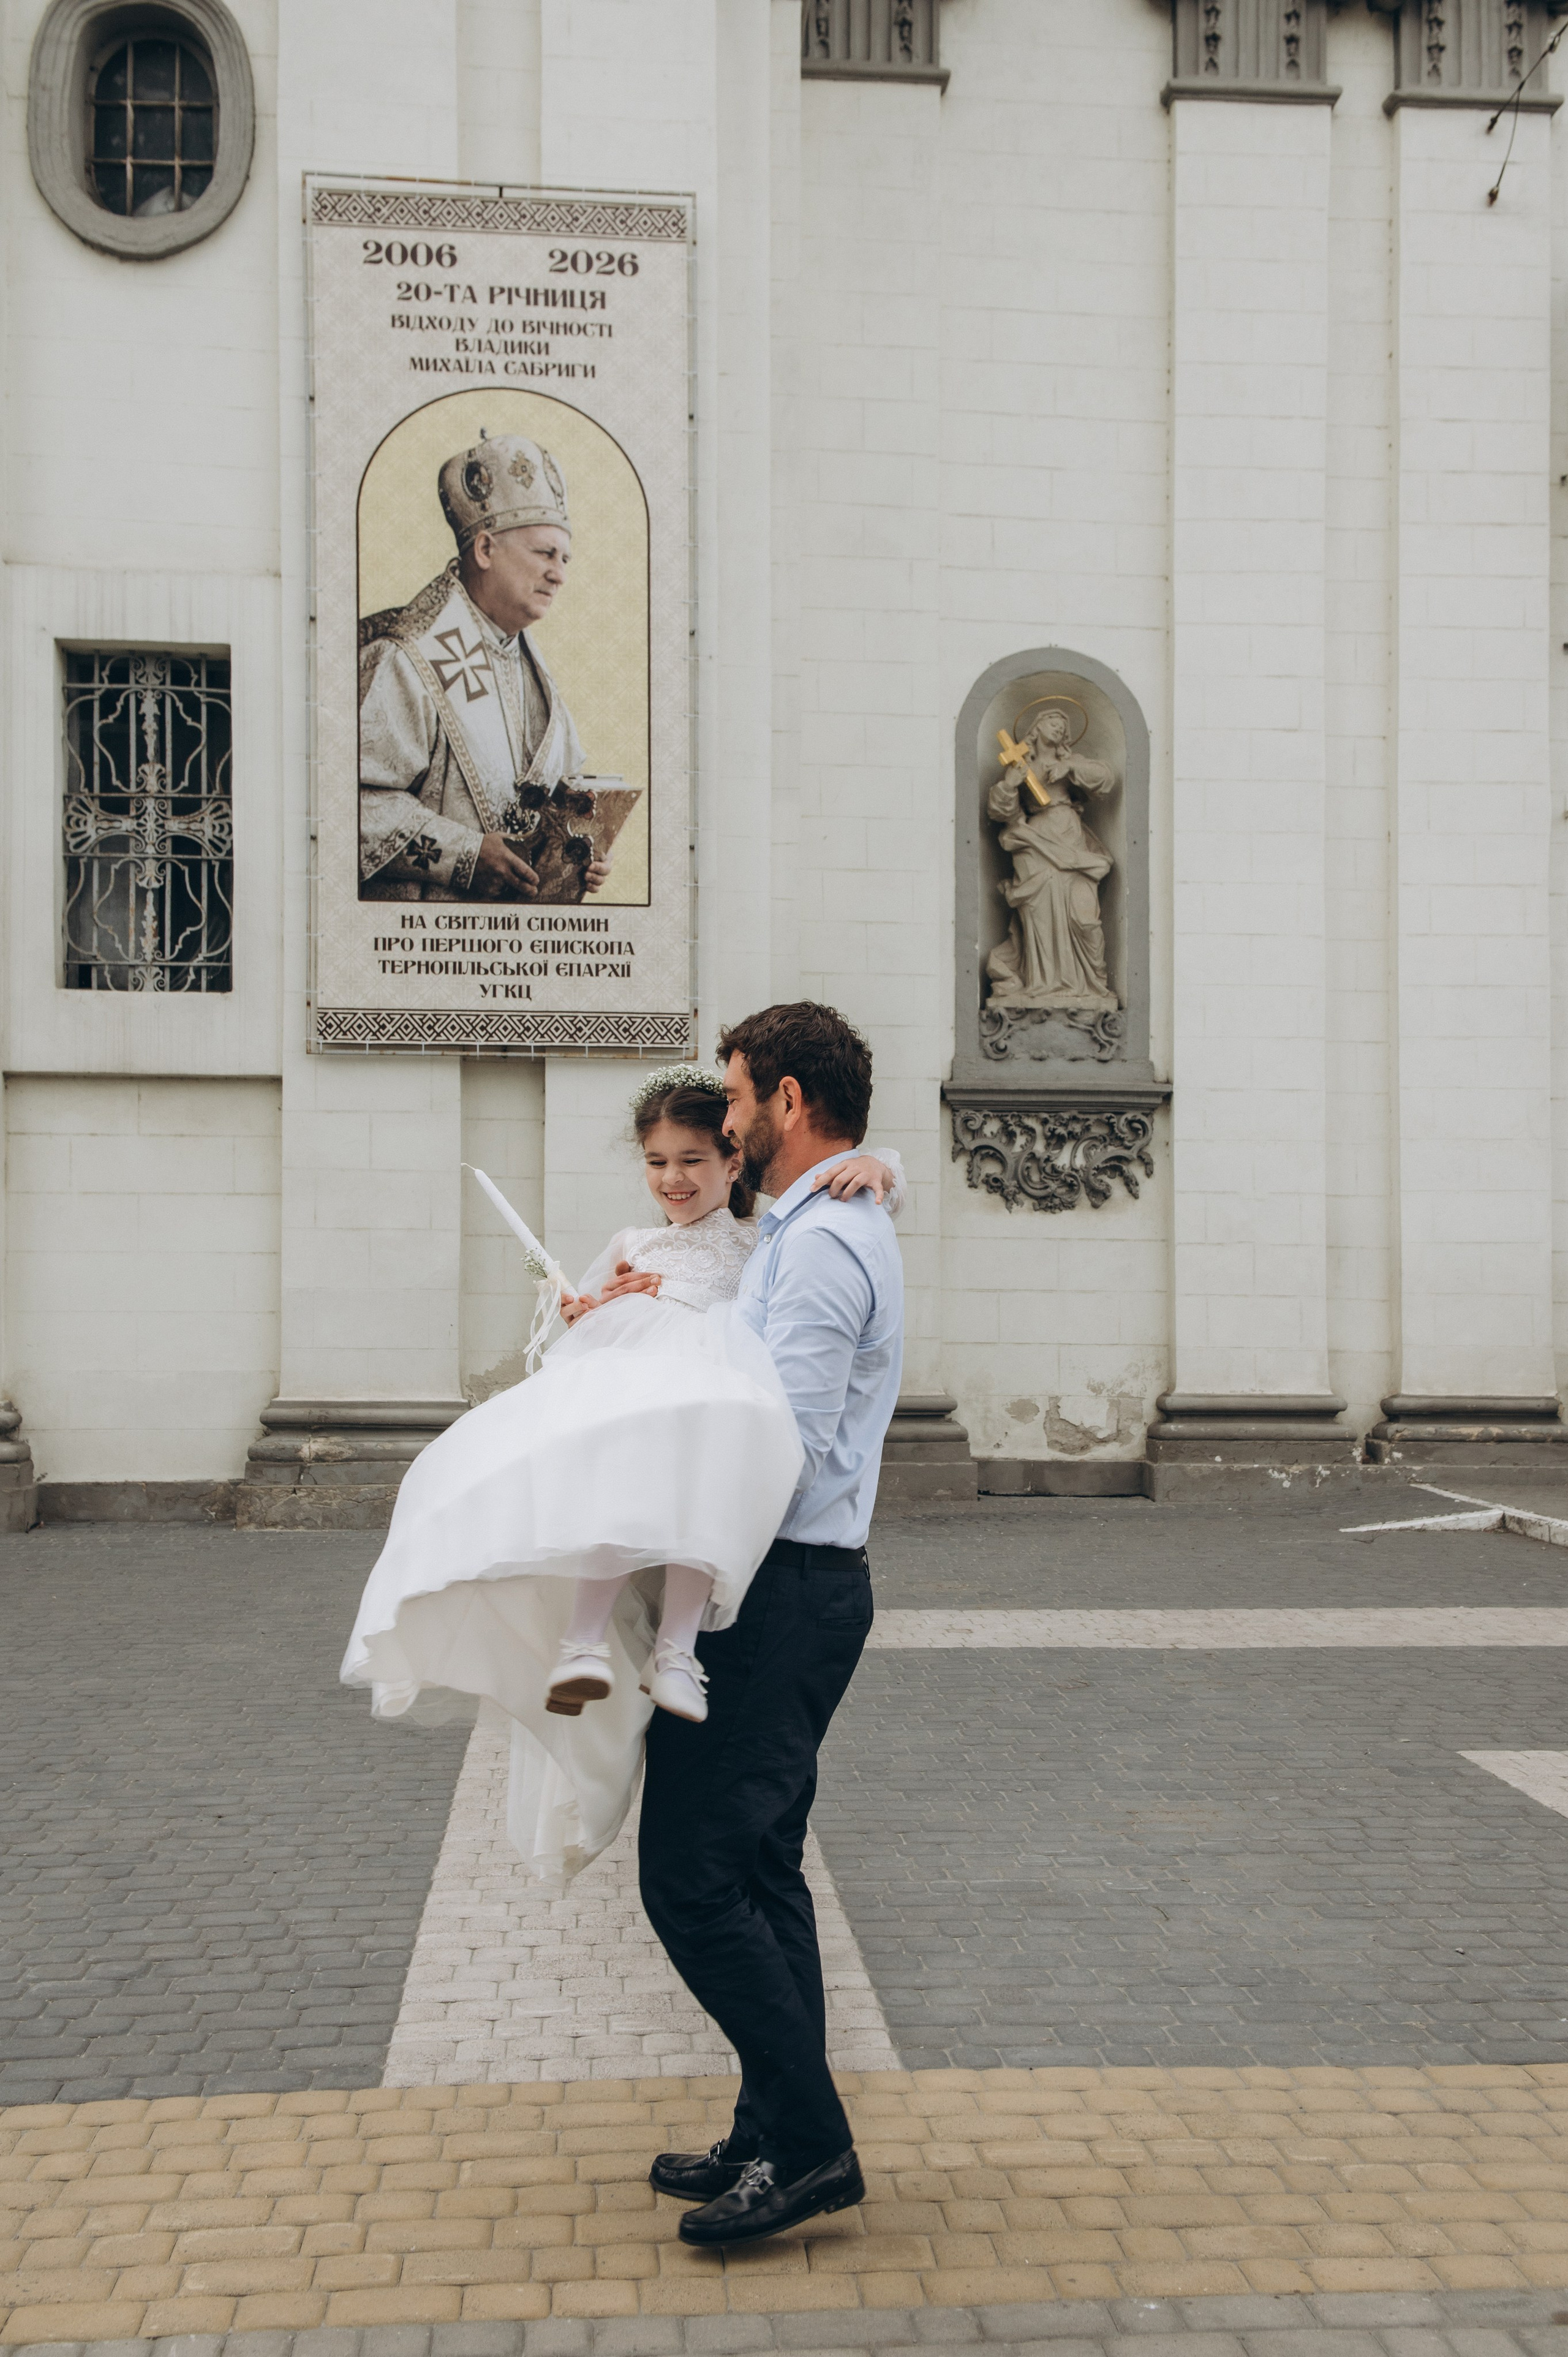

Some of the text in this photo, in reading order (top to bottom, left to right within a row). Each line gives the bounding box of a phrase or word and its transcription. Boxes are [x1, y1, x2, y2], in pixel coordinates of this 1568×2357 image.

[362, 240, 639, 277] 2006 2026
[396, 282, 606, 310] 20-ТА РІЧНИЦЯ
[391, 314, 612, 338] ВІДХОДУ ДО ВІЧНОСТІ
[455, 338, 549, 356] ВЛАДИКИ
[410, 356, 596, 379] МИХАЇЛА САБРИГИ
[401, 913, 609, 932] НА СВІТЛИЙ СПОМИН
[374, 937, 635, 956] ПРО ПЕРШОГО ЄПИСКОПА
[377, 959, 631, 978] ТЕРНОПІЛЬСЬКОЇ ЄПАРХІЇ
[479, 984, 532, 1001] УГКЦ
